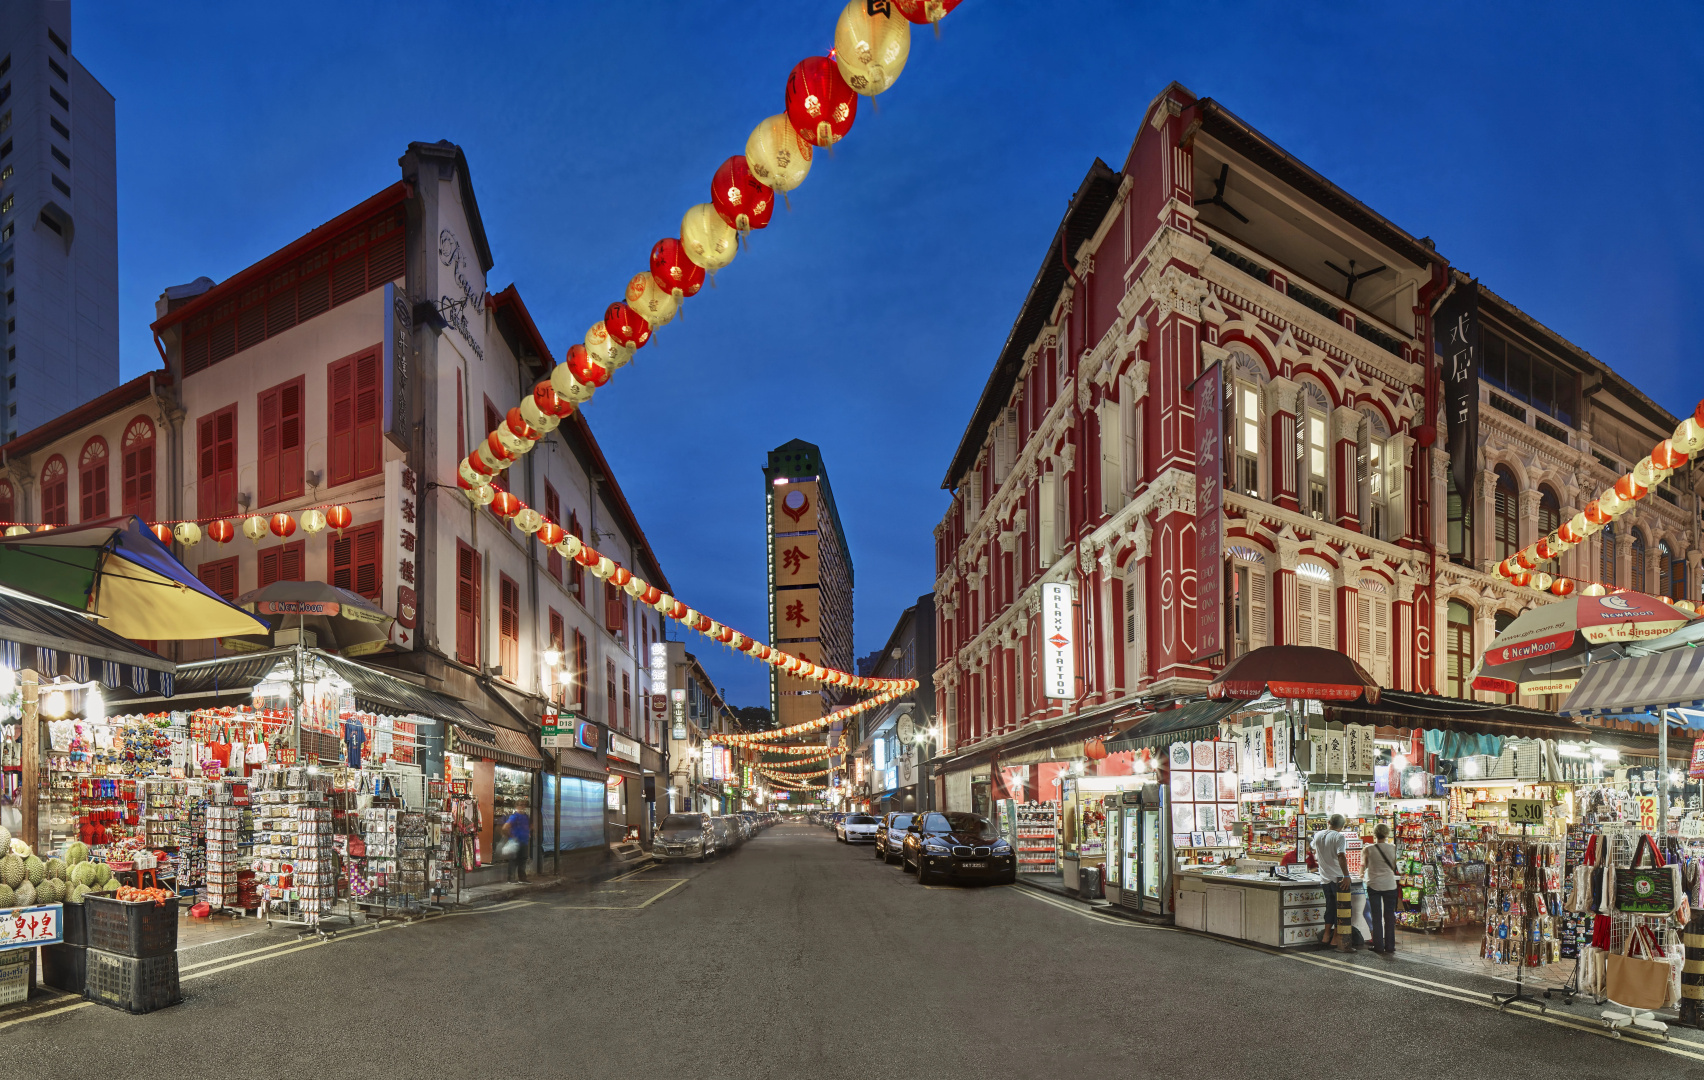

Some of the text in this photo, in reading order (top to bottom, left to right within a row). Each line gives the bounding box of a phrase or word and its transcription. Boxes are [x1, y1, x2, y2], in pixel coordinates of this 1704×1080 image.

[1200, 564, 1216, 580] CHOP
[278, 602, 323, 613] New Moon
[1053, 587, 1062, 632] GALAXY
[1201, 597, 1214, 611] ONN
[1200, 611, 1216, 627] TONG
[1623, 610, 1655, 618] Moon
[1202, 632, 1215, 650] 16
[1590, 632, 1607, 640] No.
[1608, 627, 1614, 637] 1
[1511, 641, 1556, 658] New Moon
[1056, 650, 1065, 695] TATTOO
[282, 755, 295, 763] $10
[1510, 803, 1542, 820] 5 $10
[1623, 802, 1629, 820] 5
[12, 912, 54, 940] 皇中皇
